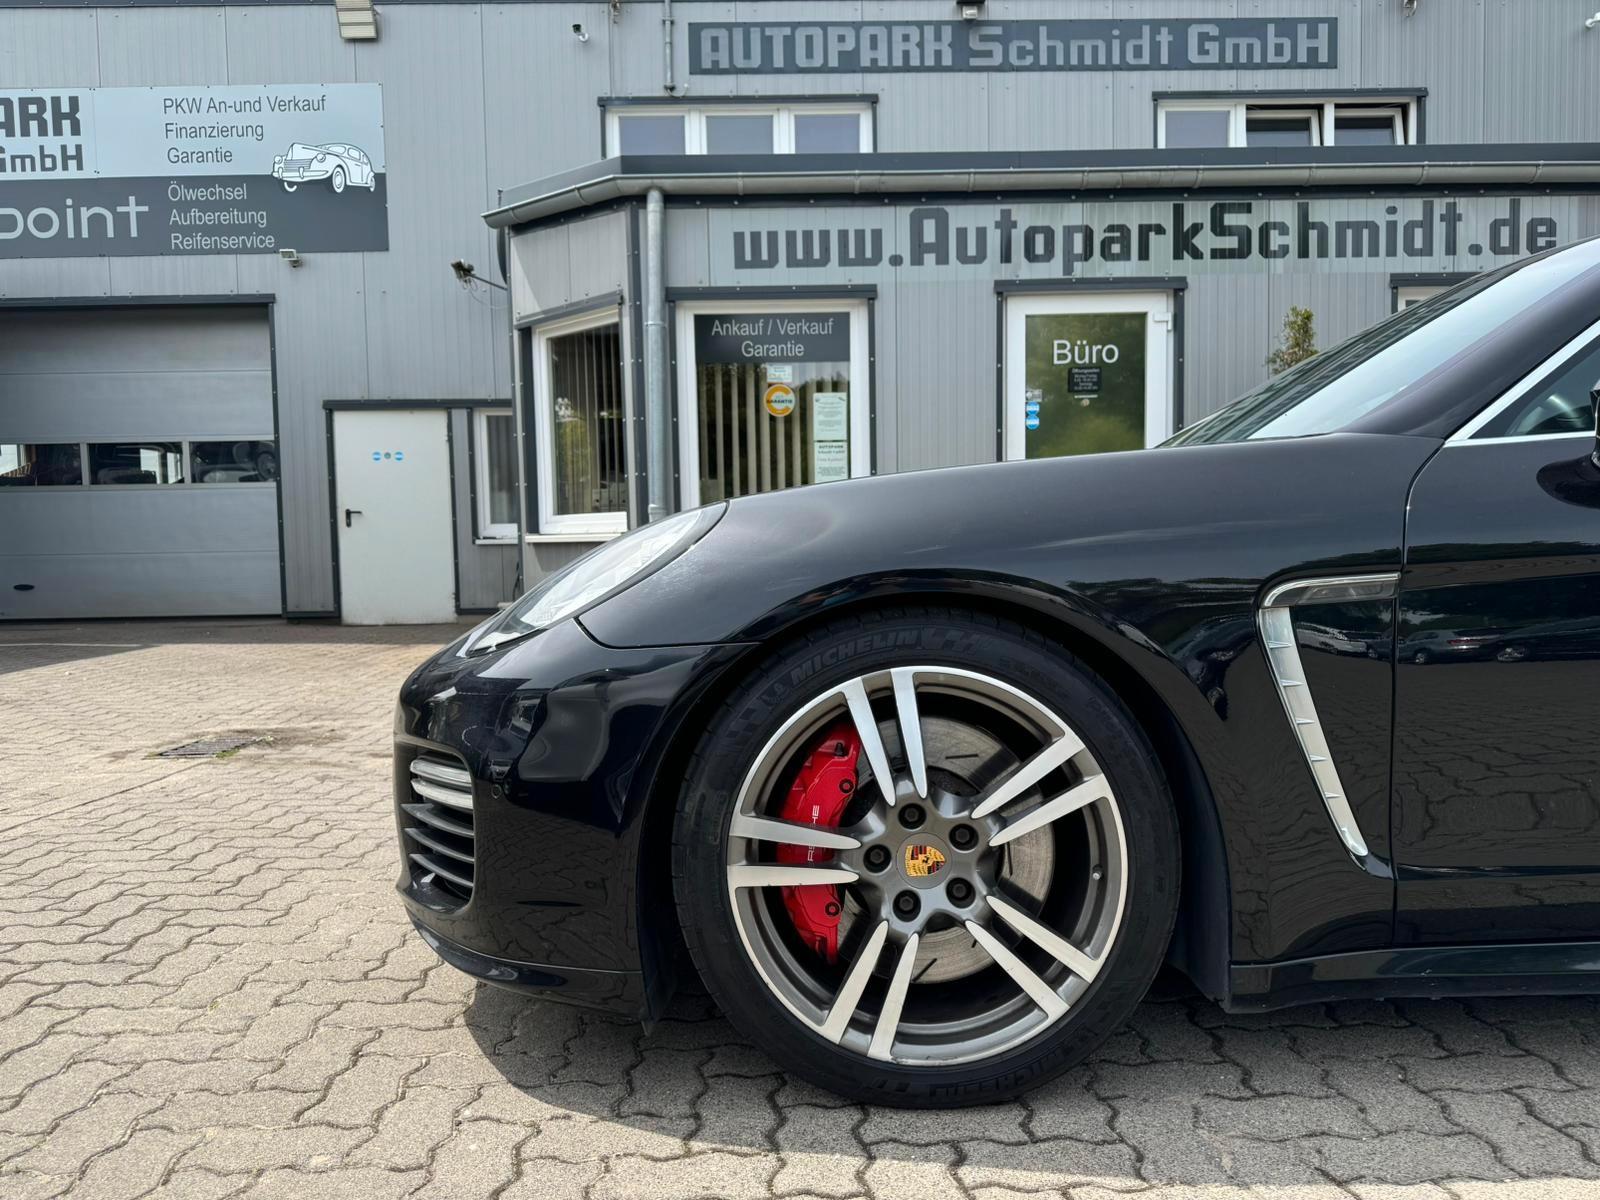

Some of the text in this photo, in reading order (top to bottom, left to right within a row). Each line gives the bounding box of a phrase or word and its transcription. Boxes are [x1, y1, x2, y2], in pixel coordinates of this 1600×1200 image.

[702, 23, 1329, 69] AUTOPARK Schmidt GmbH
[163, 94, 327, 115] PKW An-und Verkauf
[165, 122, 264, 141] Finanzierung
[167, 147, 233, 164] Garantie
[168, 180, 247, 201] Ölwechsel
[170, 208, 267, 228] Aufbereitung
[171, 232, 275, 250] Reifenservice
[734, 198, 1557, 275] www.AutoparkSchmidt.de
[711, 319, 764, 336] Ankauf
[777, 318, 835, 335] Verkauf
[741, 341, 804, 357] Garantie
[1053, 339, 1119, 365] Büro
[790, 629, 920, 684] MICHELIN
